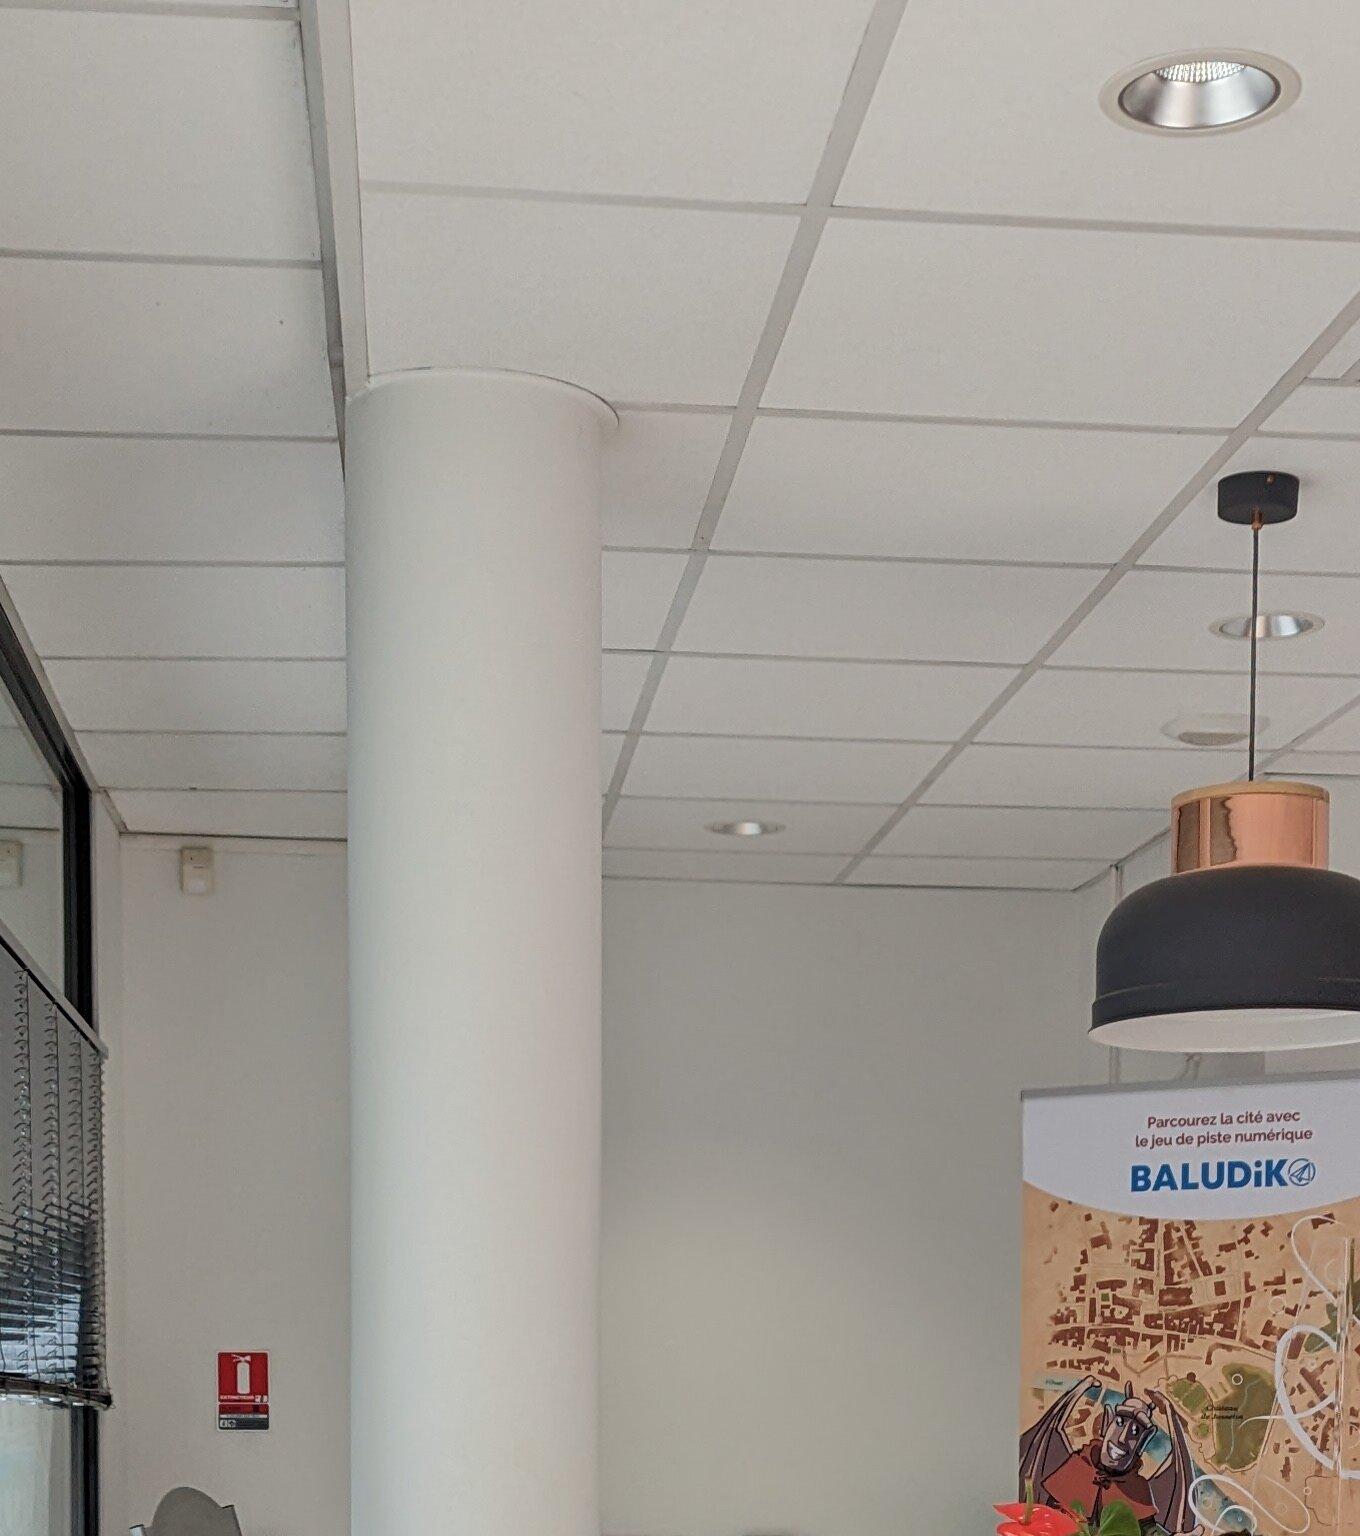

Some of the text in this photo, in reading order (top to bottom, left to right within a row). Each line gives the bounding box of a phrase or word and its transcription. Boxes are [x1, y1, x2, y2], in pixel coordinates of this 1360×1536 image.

[1147, 1110, 1300, 1128] Parcourez la cité avec
[1135, 1128, 1313, 1149] le jeu de piste numérique
